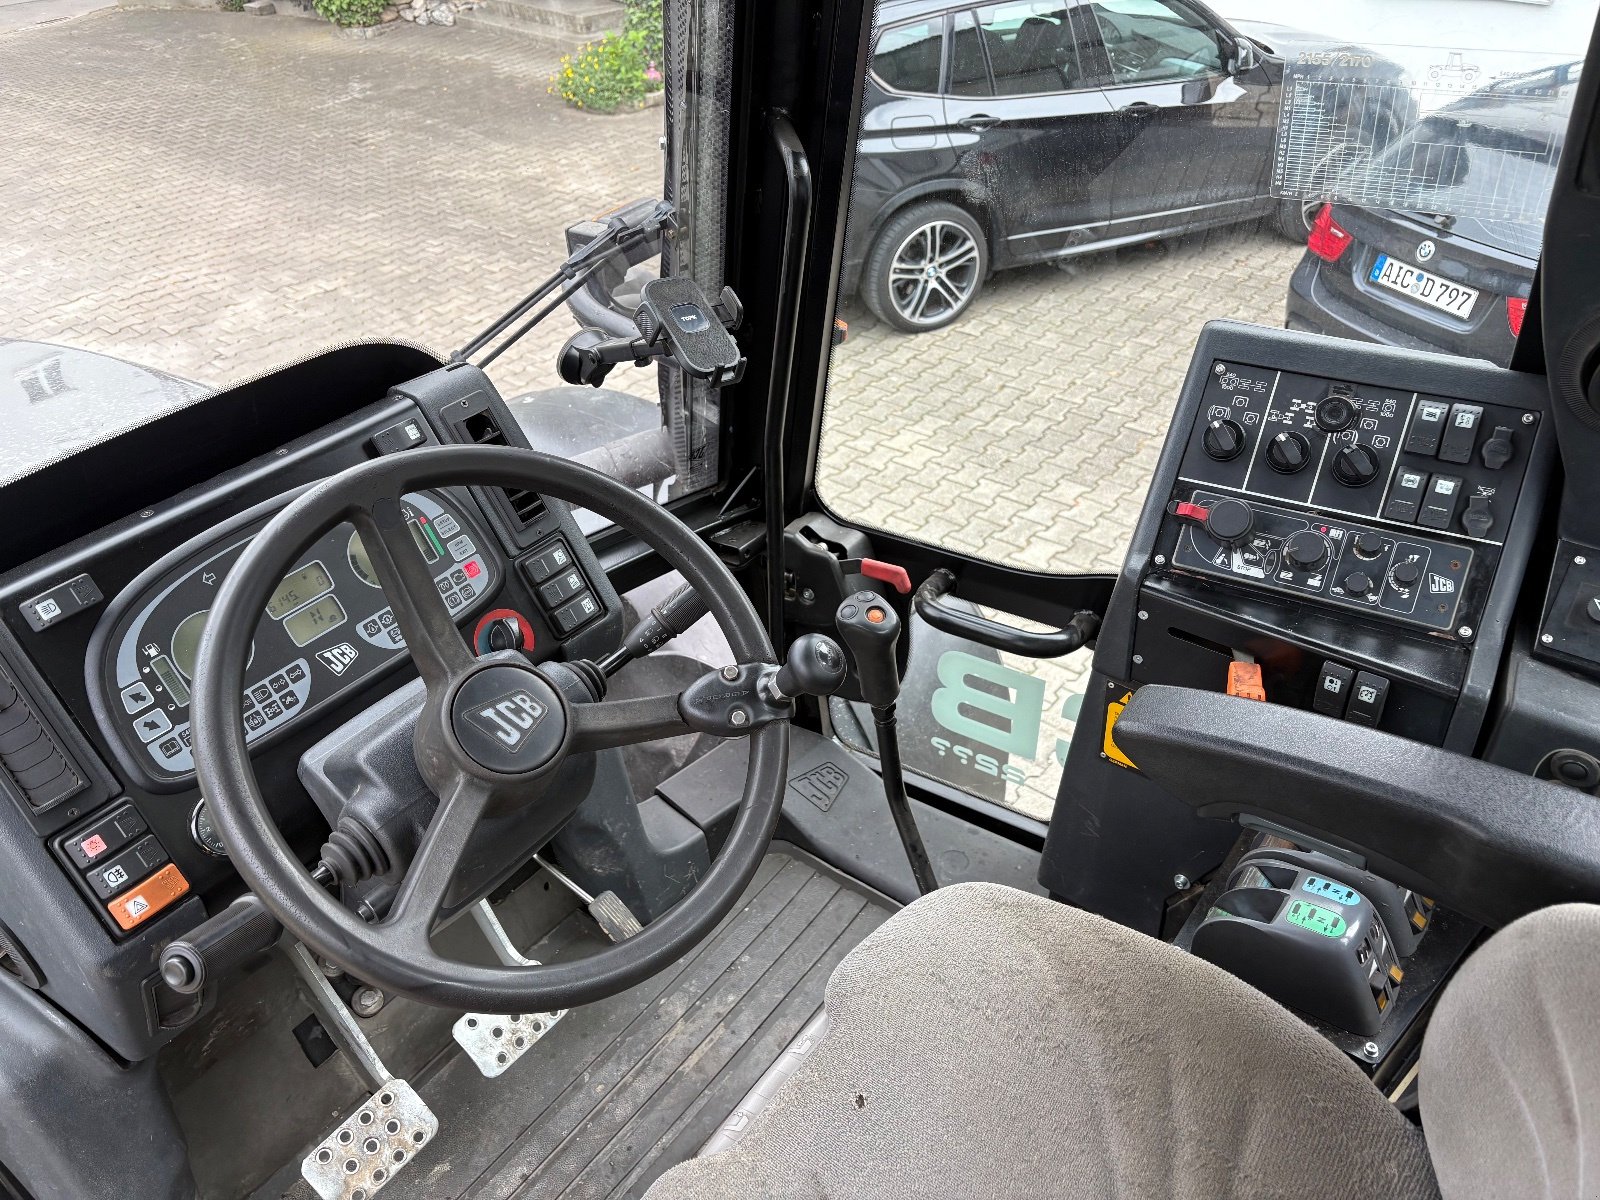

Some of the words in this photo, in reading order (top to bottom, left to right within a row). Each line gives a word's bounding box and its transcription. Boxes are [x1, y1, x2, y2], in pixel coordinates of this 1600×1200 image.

[1297, 51, 1372, 68] 2155/2170
[1382, 262, 1414, 289] AIC
[1420, 277, 1435, 298] D
[1436, 284, 1472, 311] 797
[1432, 575, 1454, 592] JCB
[323, 642, 356, 673] JCB
[478, 694, 543, 746] JCB
[798, 764, 846, 808] JCB
